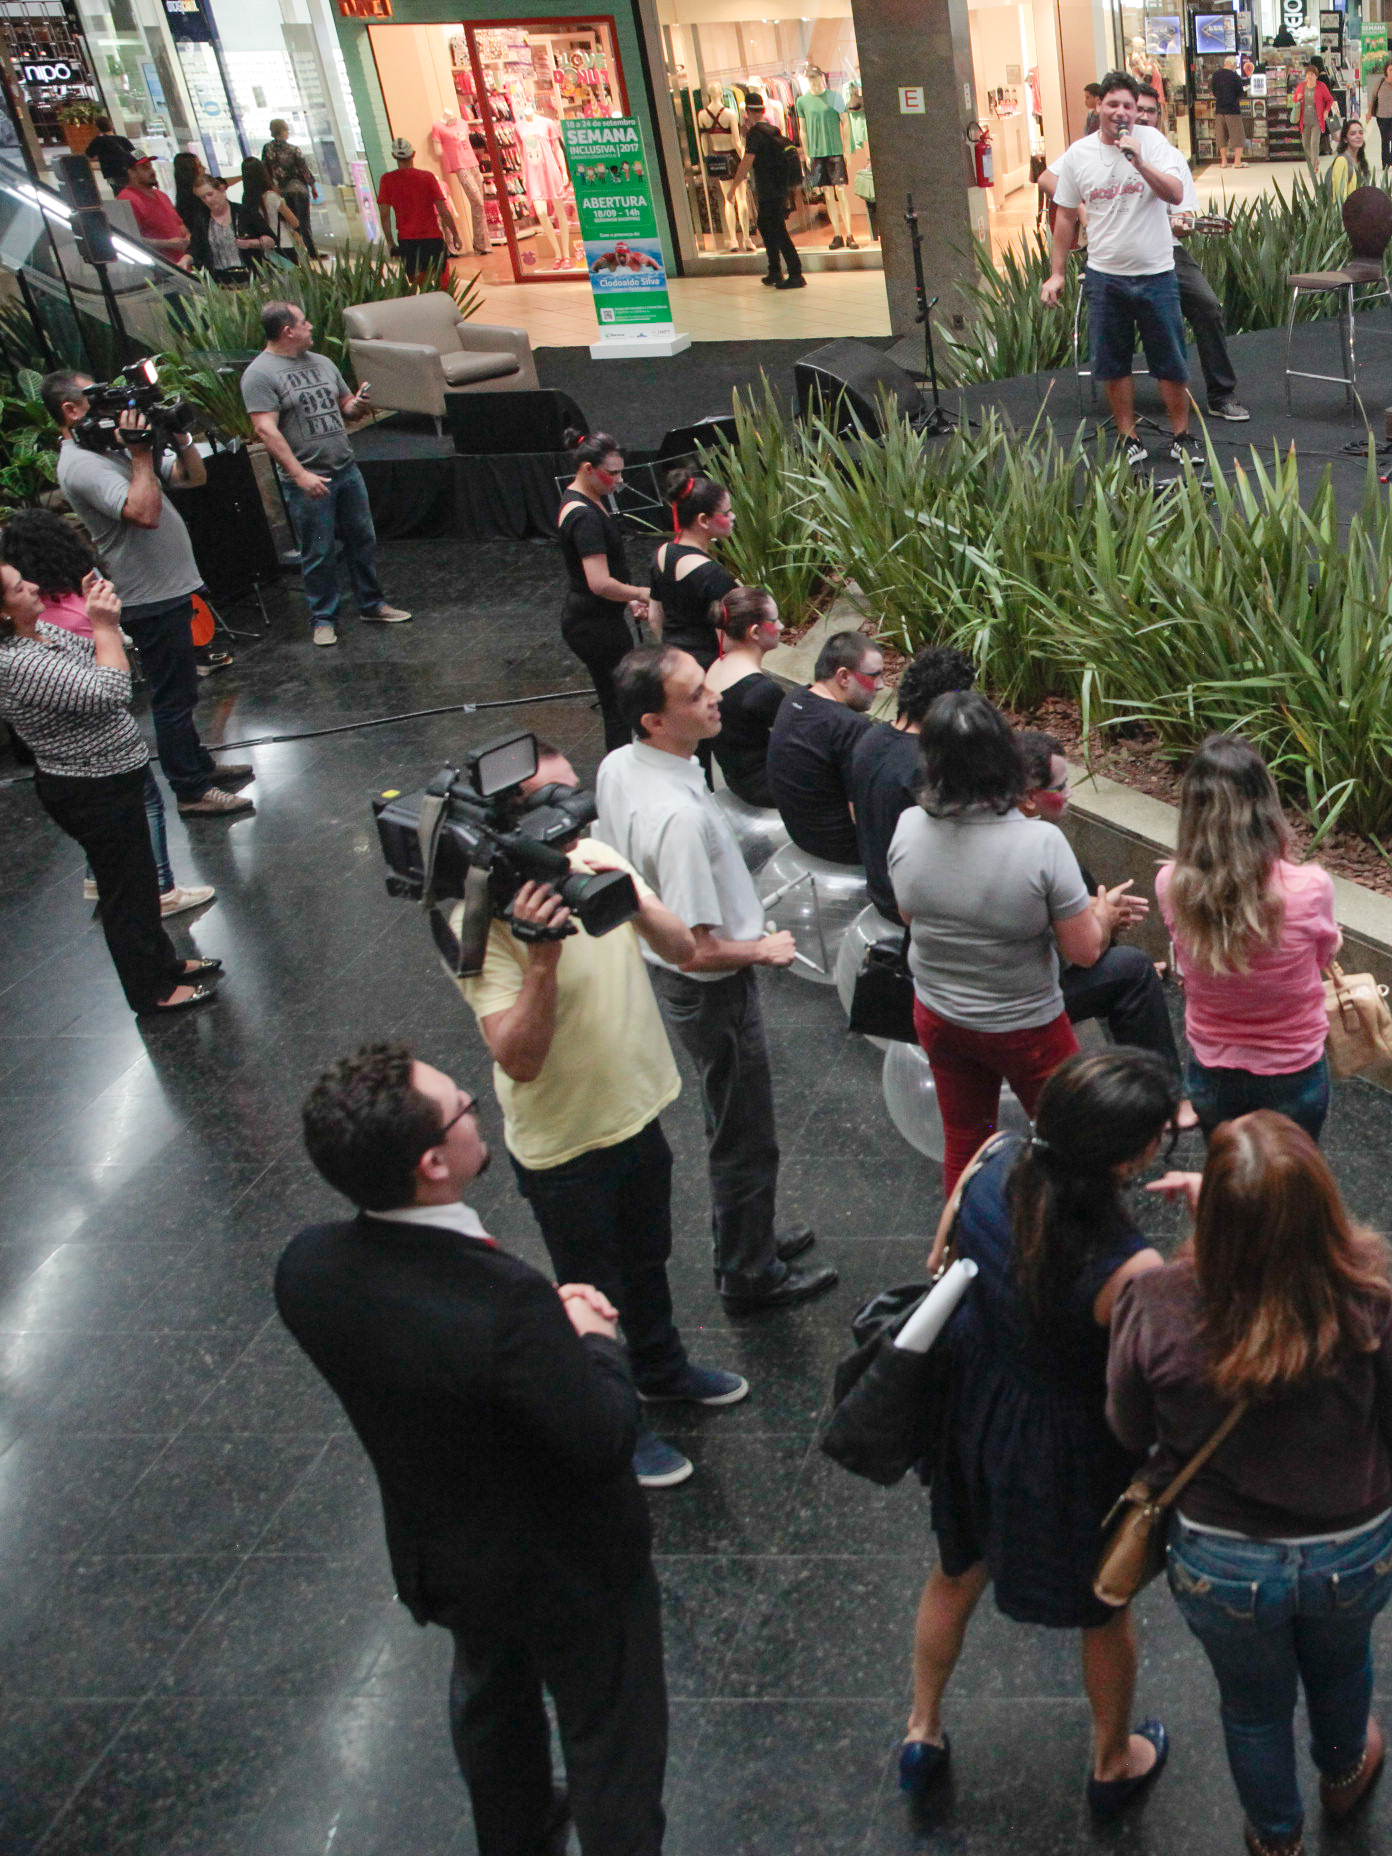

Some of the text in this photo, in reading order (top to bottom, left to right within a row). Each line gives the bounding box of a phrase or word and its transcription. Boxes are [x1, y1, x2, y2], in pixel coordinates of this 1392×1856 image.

[561, 50, 607, 69] LOVE
[904, 90, 919, 108] E
[602, 119, 636, 127] setembro
[567, 127, 638, 145] SEMANA
[569, 144, 639, 155] INCLUSIVA 2017
[583, 195, 648, 209] ABERTURA
[593, 209, 617, 218] 18/09
[625, 208, 640, 217] 14h
[600, 277, 660, 287] Clodoaldo Silva
[299, 387, 335, 414] 98
